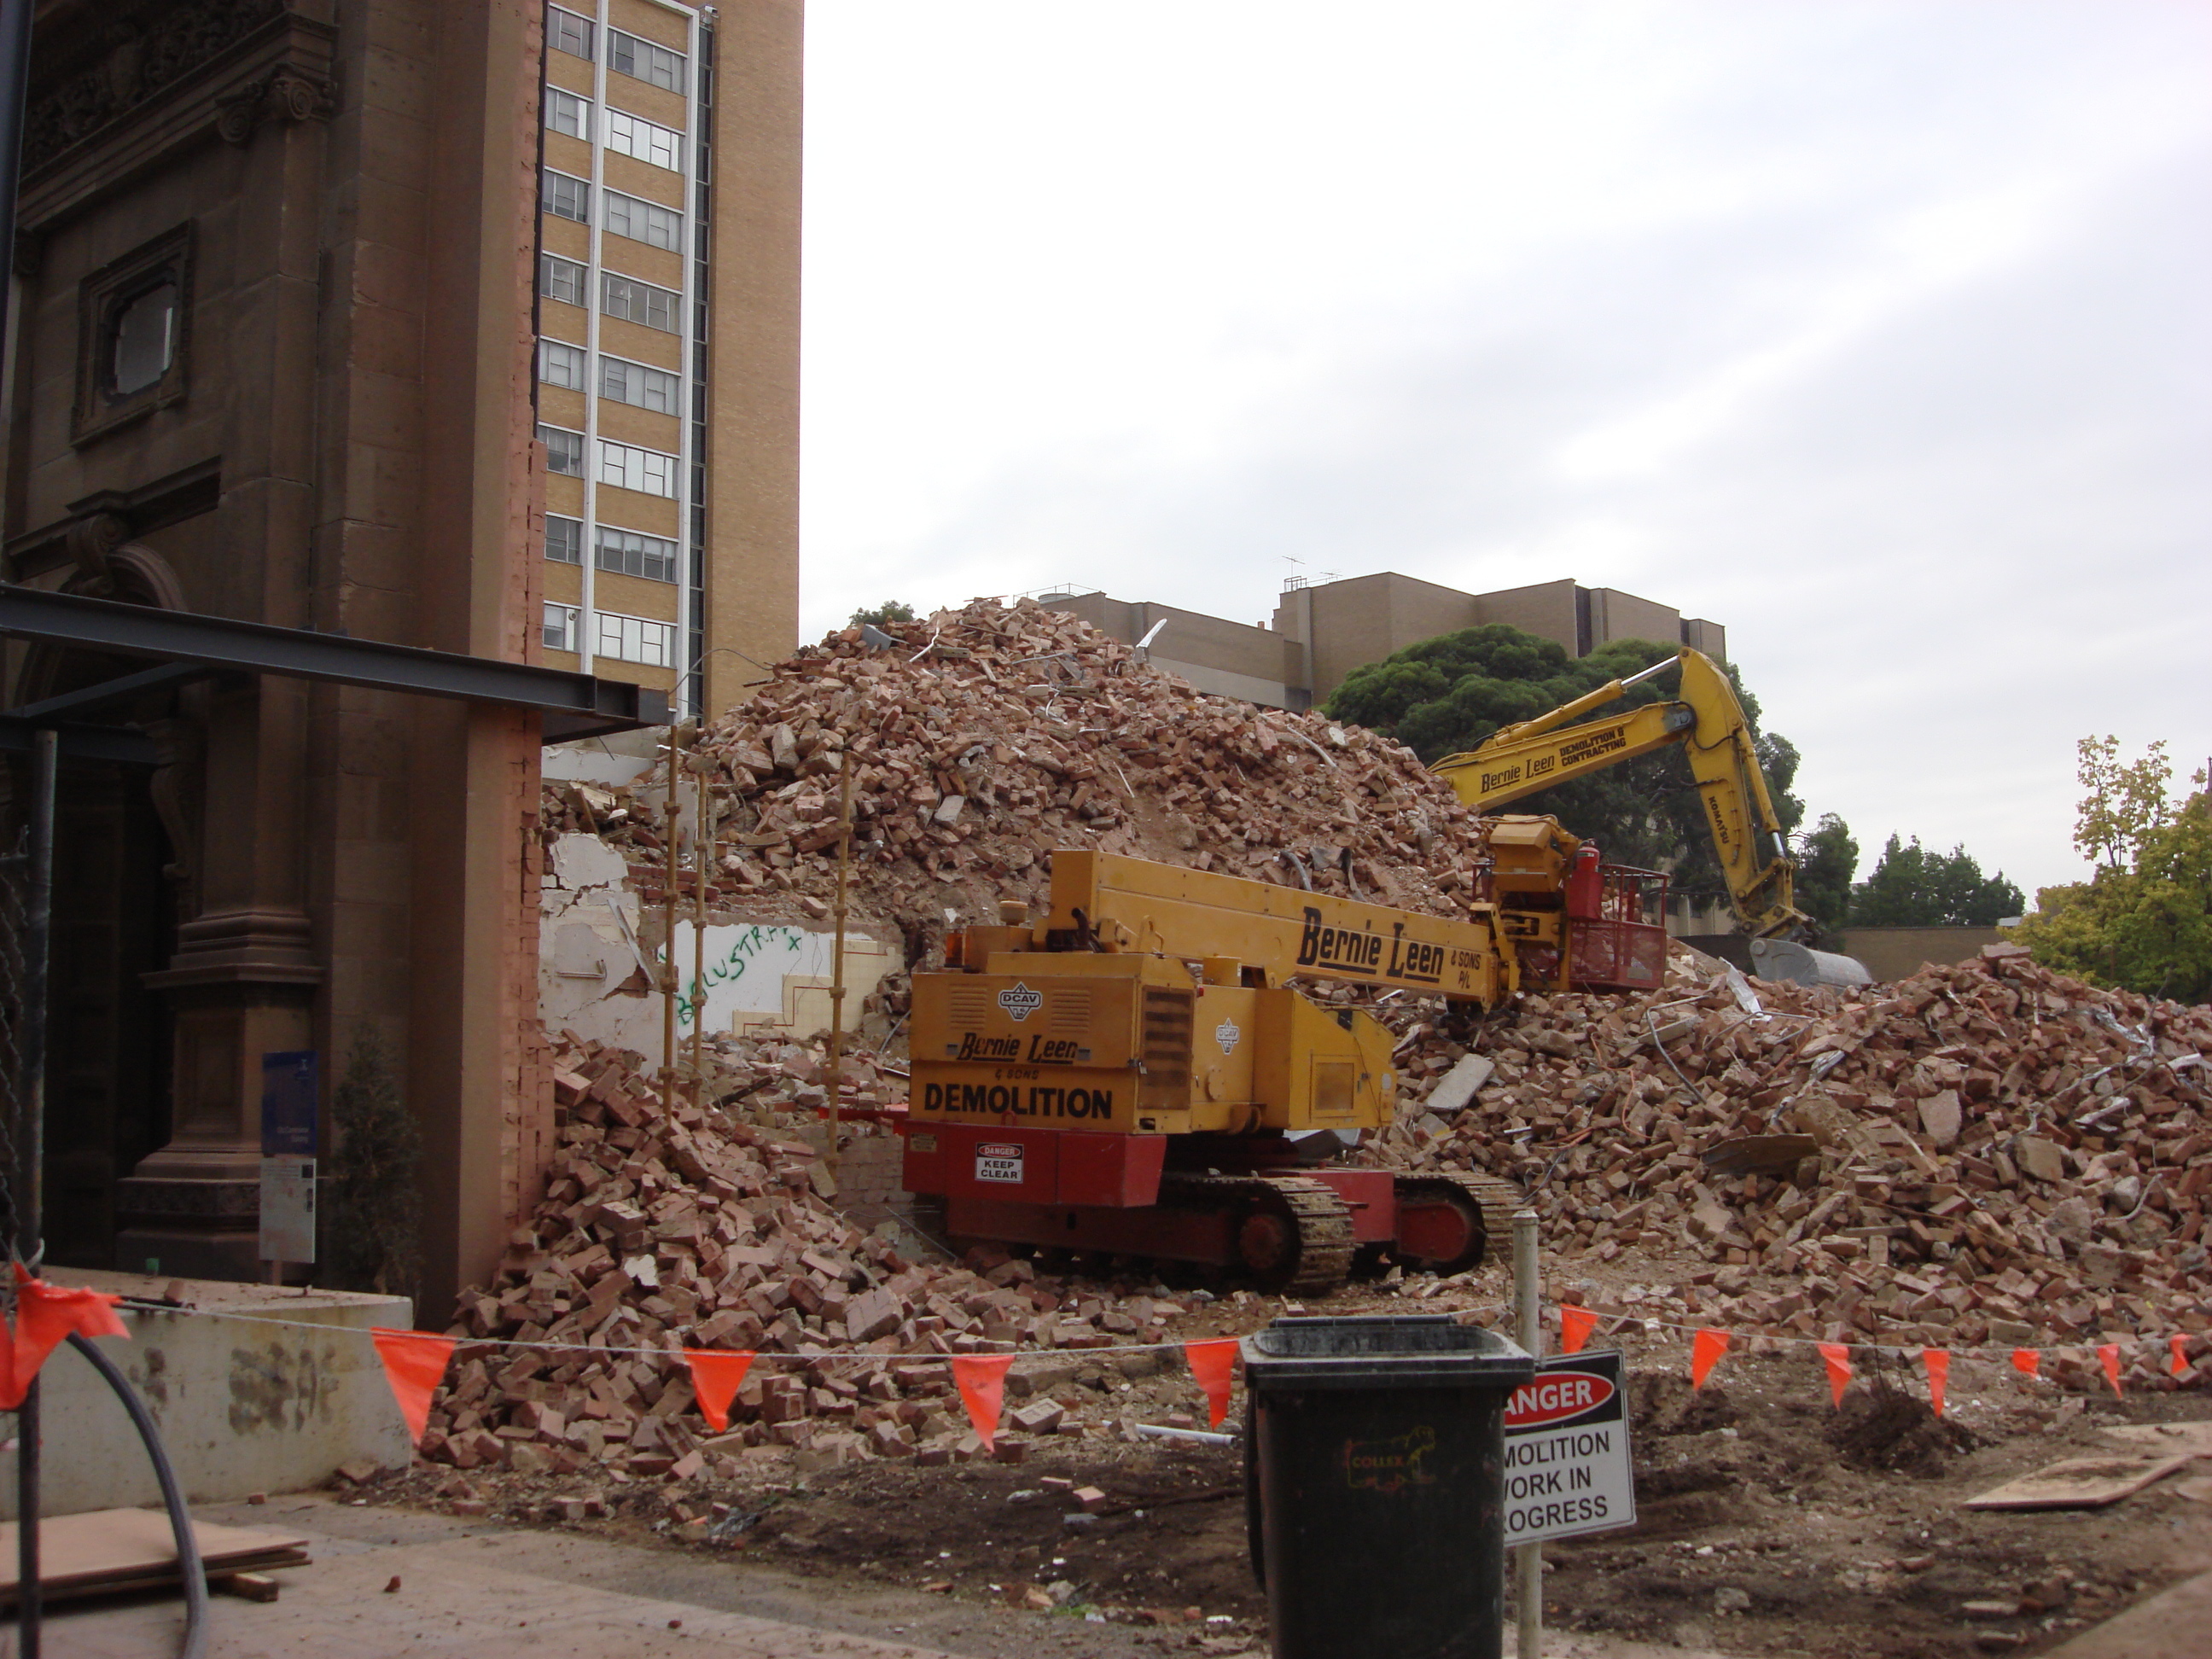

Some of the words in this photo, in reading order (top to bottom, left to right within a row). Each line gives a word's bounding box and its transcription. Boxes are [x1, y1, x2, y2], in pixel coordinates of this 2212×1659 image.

[1559, 730, 1616, 757] DEMOLITION
[1617, 726, 1625, 736] &
[1561, 737, 1627, 767] CONTRACTING
[1481, 765, 1520, 794] Bernie
[1525, 754, 1555, 779] Leen
[1708, 795, 1730, 844] KOMATSU
[1297, 905, 1382, 969] Bernie
[1386, 922, 1445, 979] Leen
[1458, 951, 1481, 970] SONS
[1458, 970, 1471, 989] P/L
[1003, 994, 1038, 1003] DCAV
[956, 1032, 1021, 1062] Bernie
[1027, 1034, 1079, 1064] Leen
[1007, 1069, 1039, 1080] SONS
[924, 1082, 1113, 1120] DEMOLITION
[984, 1146, 1016, 1156] DANGER
[984, 1159, 1015, 1169] KEEP
[981, 1169, 1018, 1179] CLEAR
[1505, 1379, 1594, 1417] ANGER
[1505, 1430, 1611, 1469] MOLITION
[1505, 1470, 1563, 1501] ORK
[1570, 1465, 1592, 1490] IN
[1505, 1495, 1609, 1534] OGRESS
